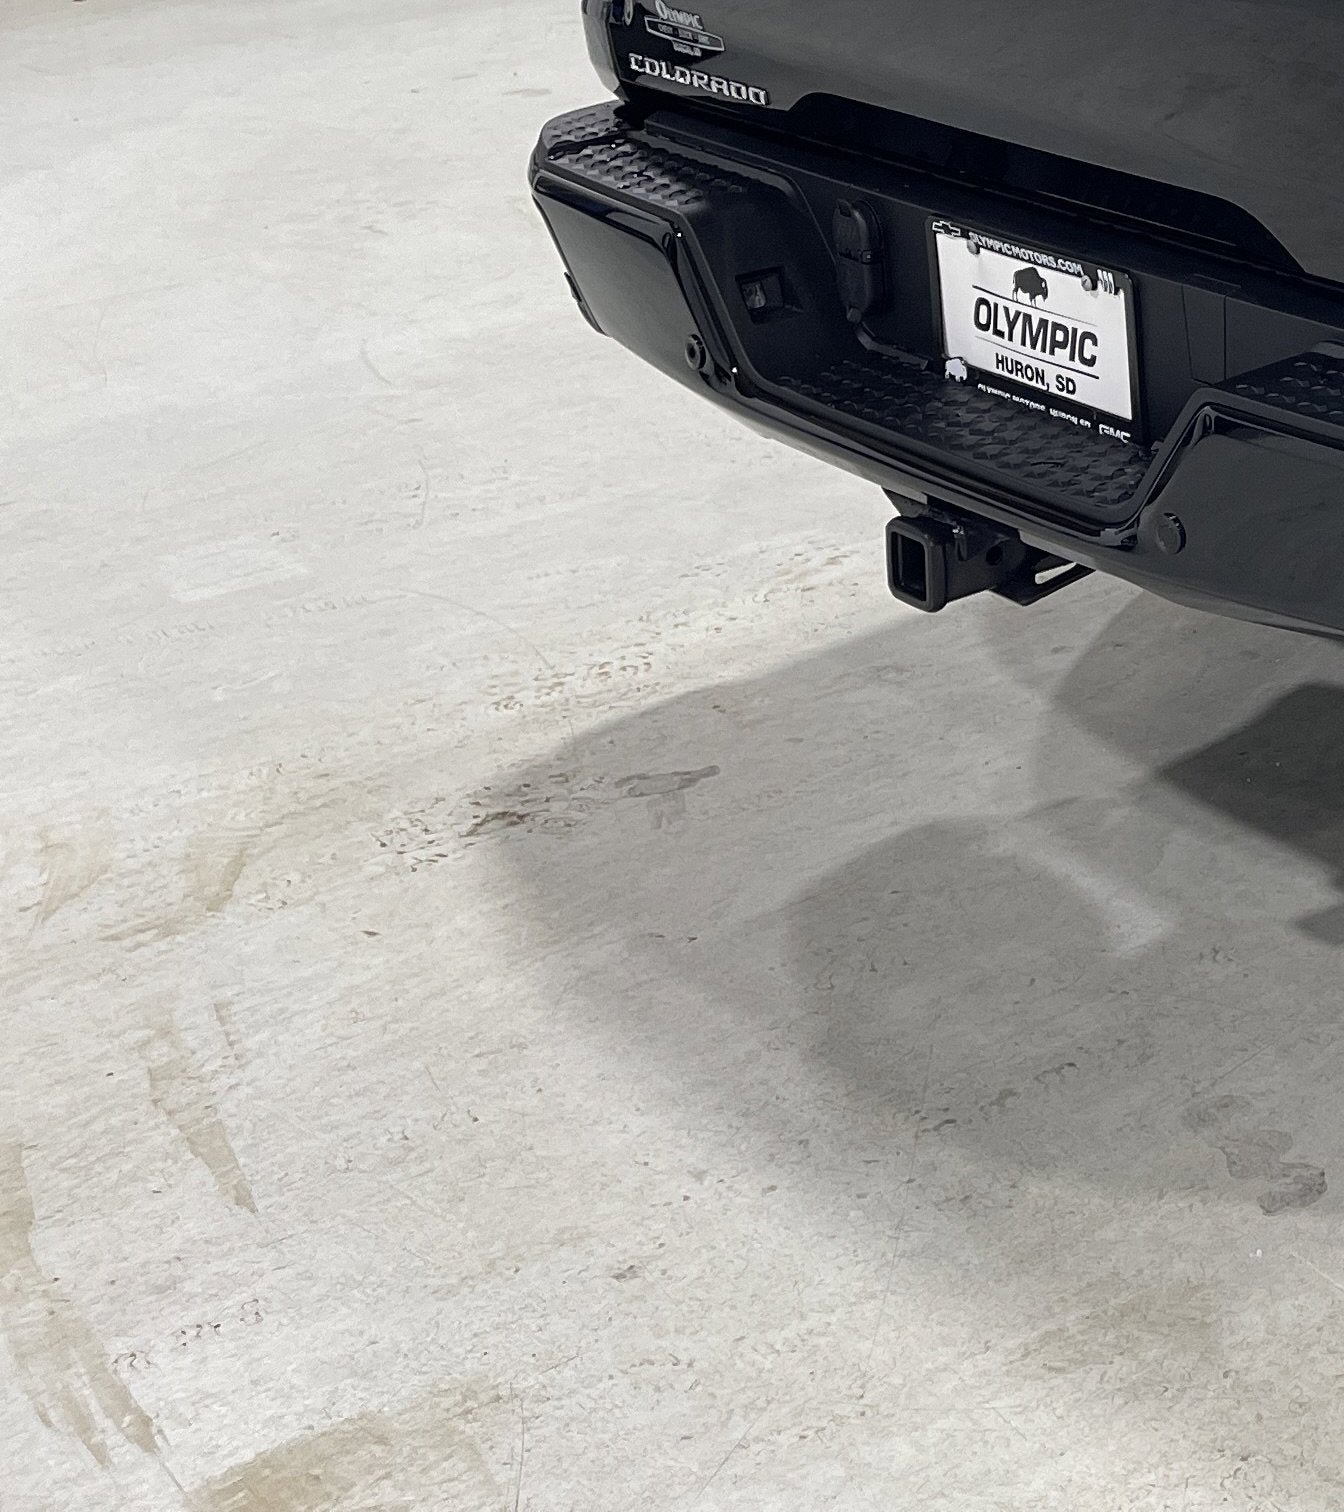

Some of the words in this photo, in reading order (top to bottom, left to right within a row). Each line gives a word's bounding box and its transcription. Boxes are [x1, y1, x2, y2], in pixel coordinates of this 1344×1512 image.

[629, 52, 768, 106] COLORADO
[968, 231, 1083, 276] OLYMPICMOTORS.COM
[973, 296, 1099, 367] OLYMPIC
[995, 352, 1050, 390] HURON,
[1056, 373, 1077, 396] SD
